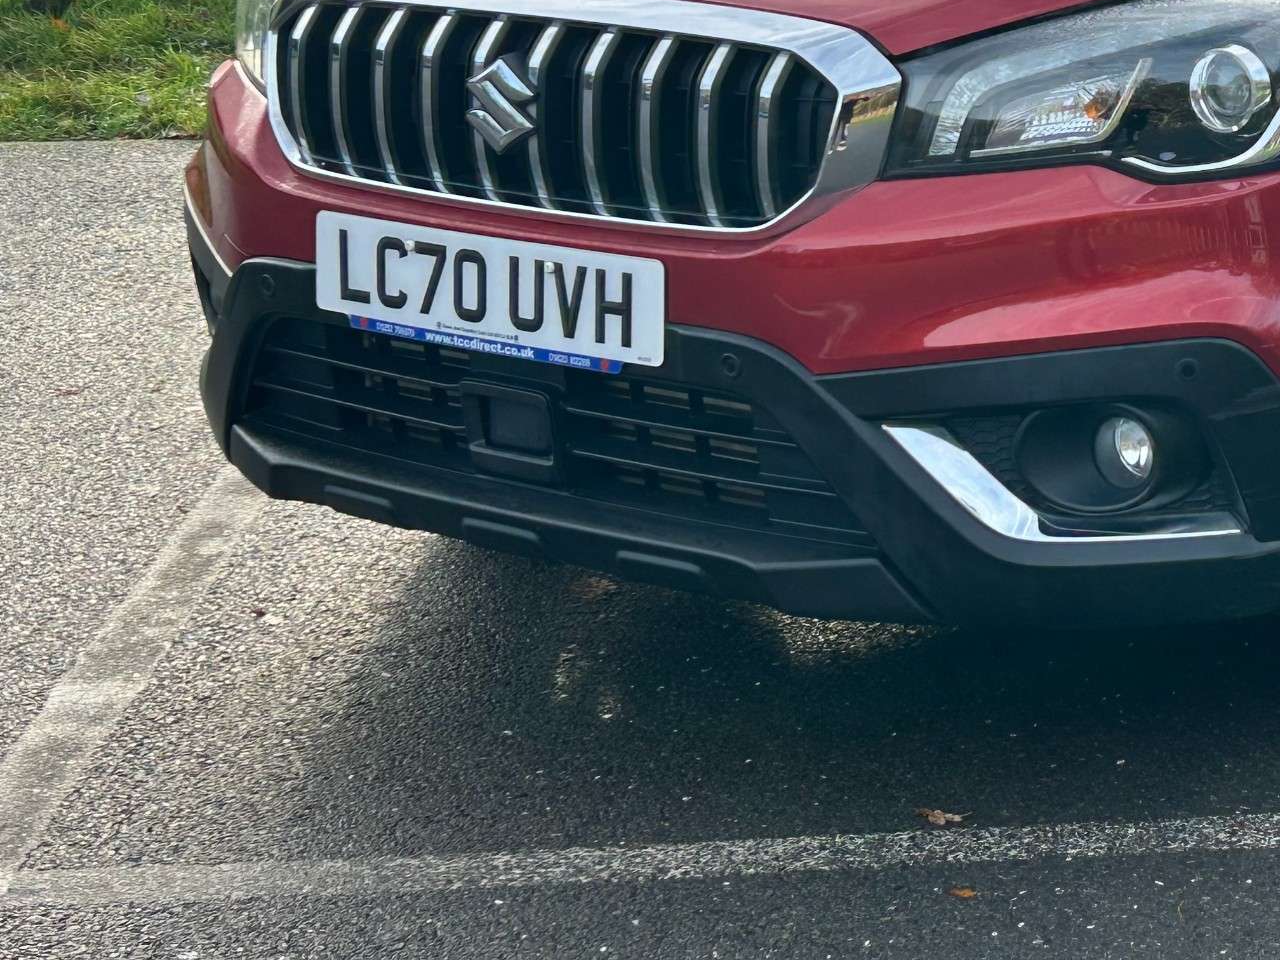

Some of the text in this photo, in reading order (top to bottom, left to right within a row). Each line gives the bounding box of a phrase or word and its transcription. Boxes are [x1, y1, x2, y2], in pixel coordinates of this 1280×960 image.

[338, 228, 633, 349] LC70 UVH
[425, 331, 535, 359] www.tccdirect.co.uk
